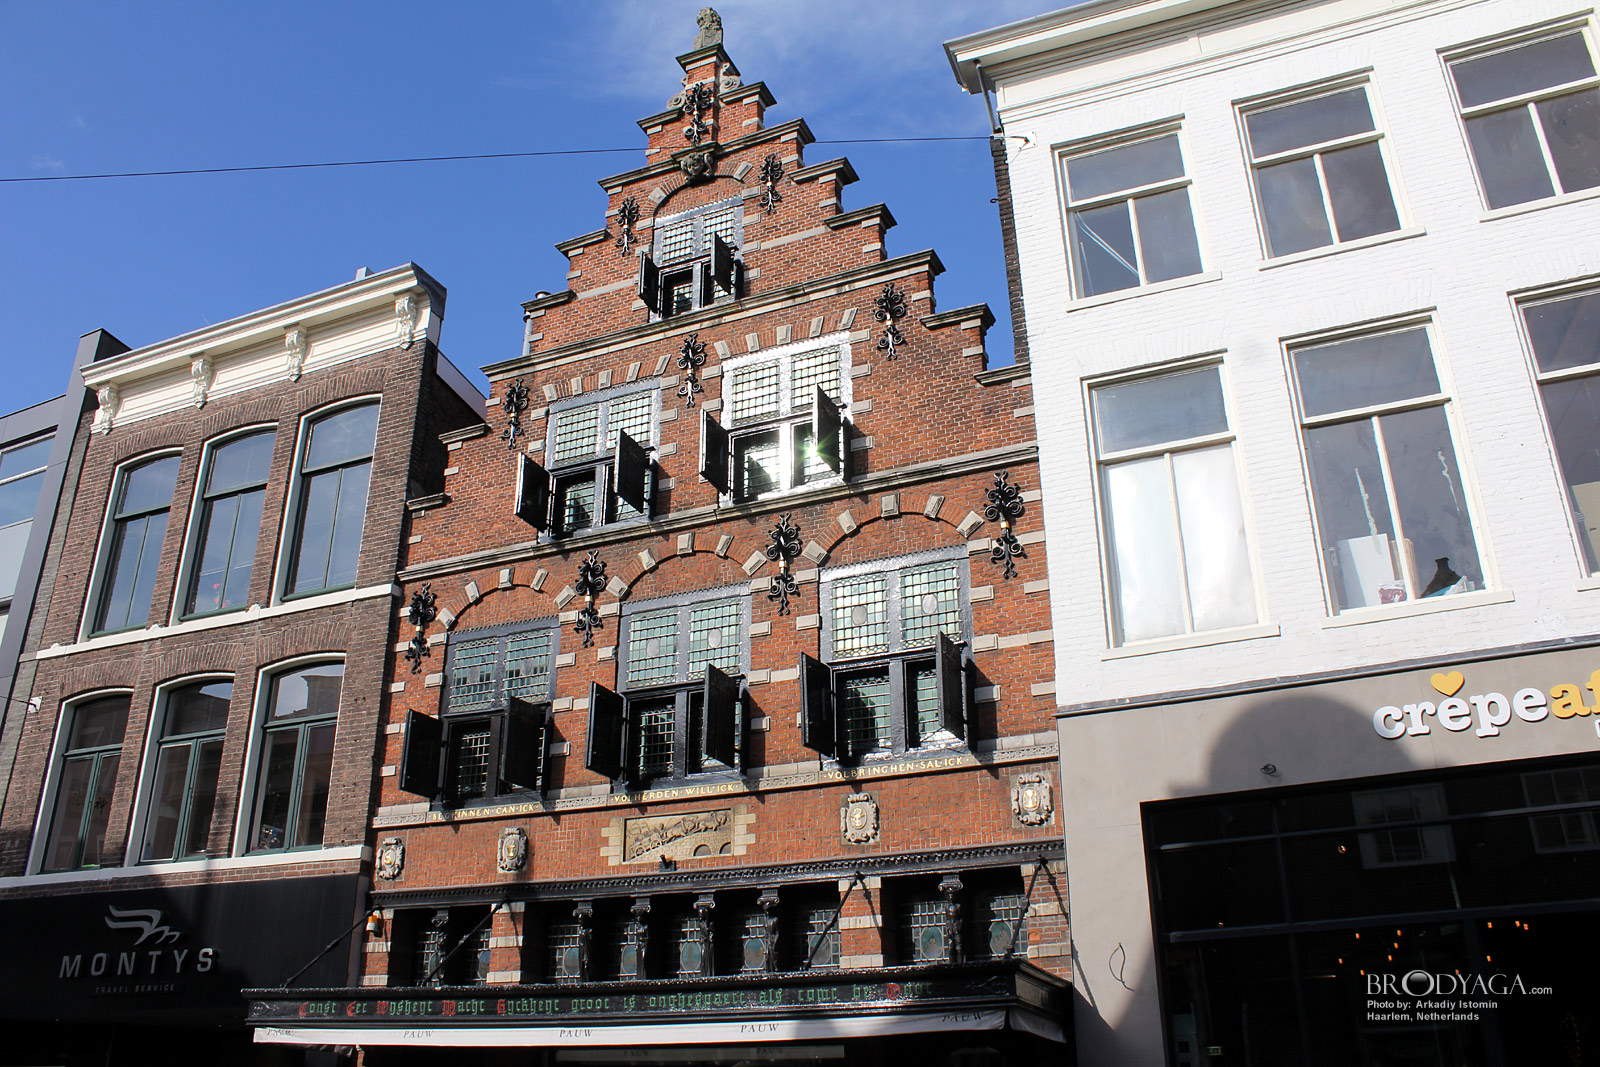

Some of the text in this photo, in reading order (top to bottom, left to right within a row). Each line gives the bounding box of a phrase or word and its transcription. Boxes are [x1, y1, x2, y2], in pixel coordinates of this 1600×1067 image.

[827, 762, 914, 779] VOLBRINGHEN
[59, 947, 214, 979] MONTYS
[95, 984, 175, 994] TRAVEL SERVICE
[298, 1001, 336, 1017] Const
[441, 999, 485, 1016] Macht
[759, 988, 783, 1005] als
[942, 1010, 984, 1023] PAUW
[559, 1029, 592, 1038] PAUW
[740, 1023, 779, 1033] PAUW
[403, 1030, 434, 1039] PAUW
